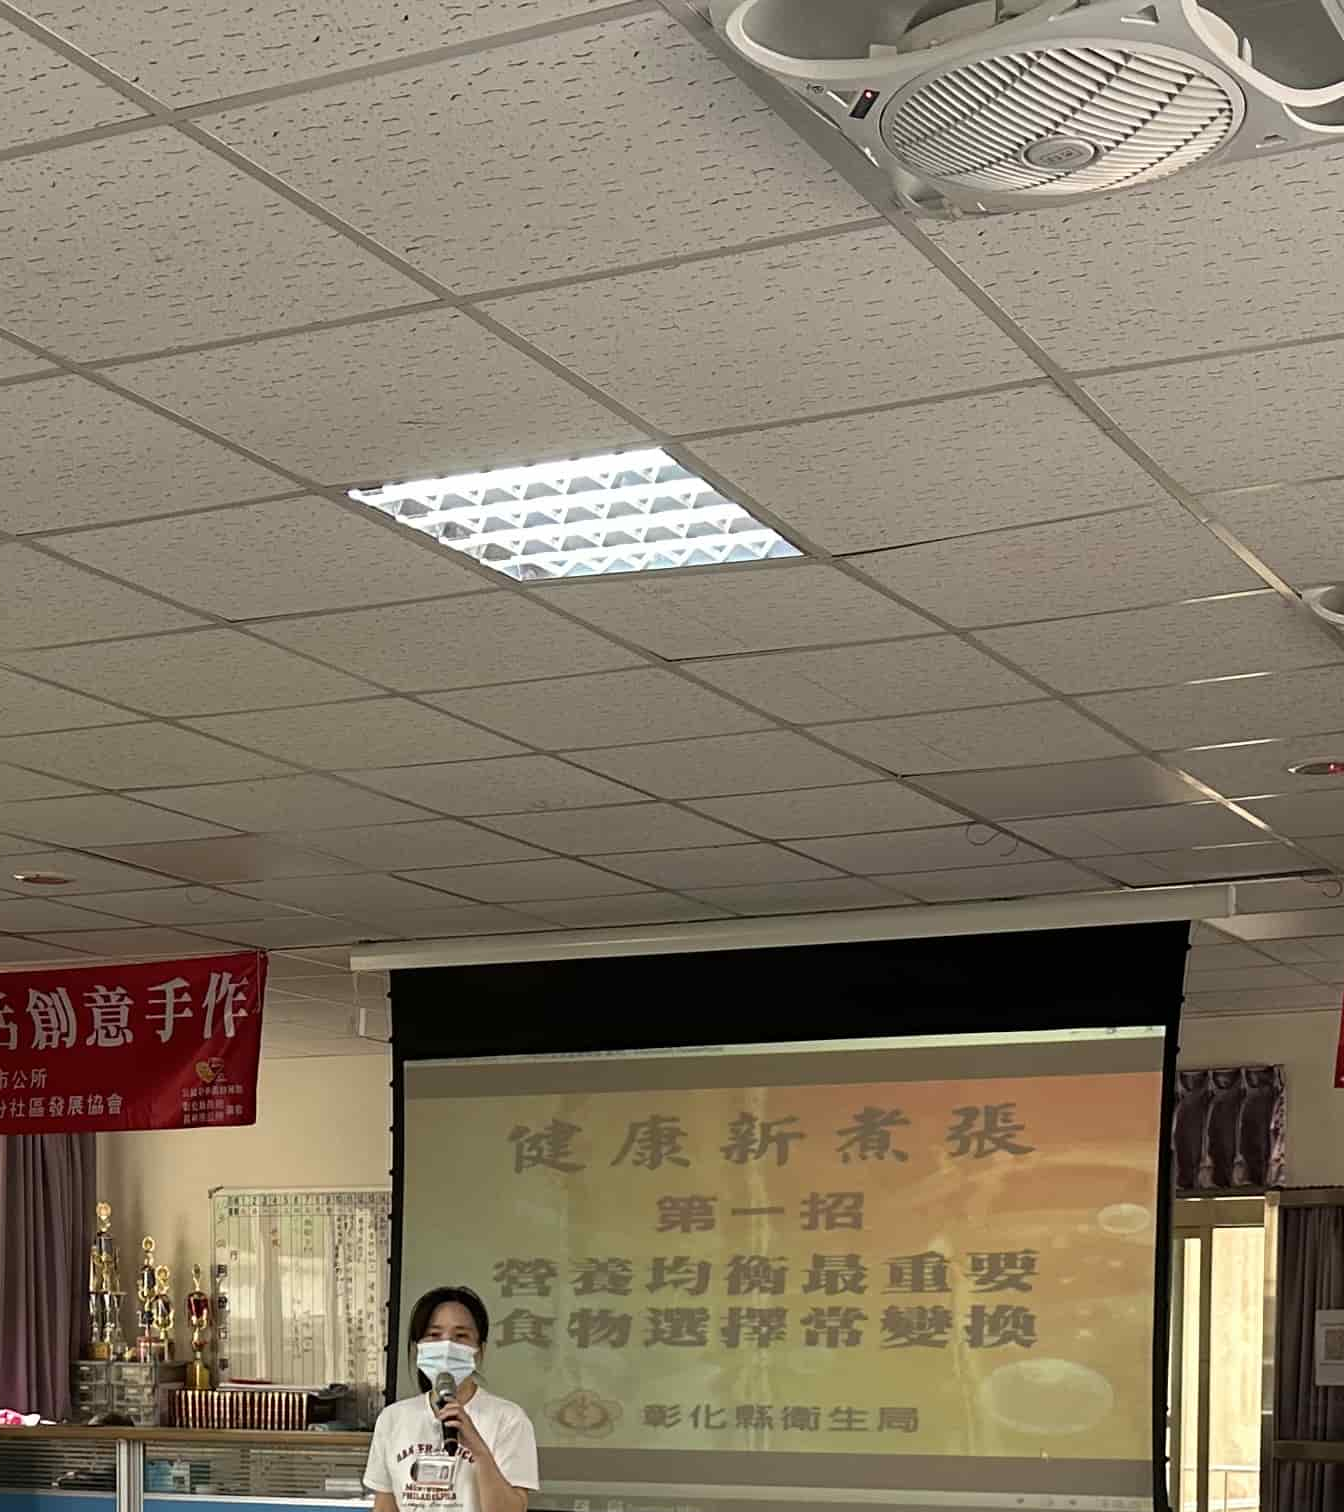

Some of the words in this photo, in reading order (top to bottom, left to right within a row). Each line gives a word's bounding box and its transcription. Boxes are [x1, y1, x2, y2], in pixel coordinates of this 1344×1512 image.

[507, 1102, 1037, 1176] 健康新煮張
[655, 1192, 866, 1234] 第一招
[493, 1250, 1042, 1298] 營養均衡最重要
[493, 1304, 1039, 1351] 食物選擇常變換
[641, 1403, 920, 1434] 彰化縣衛生局
